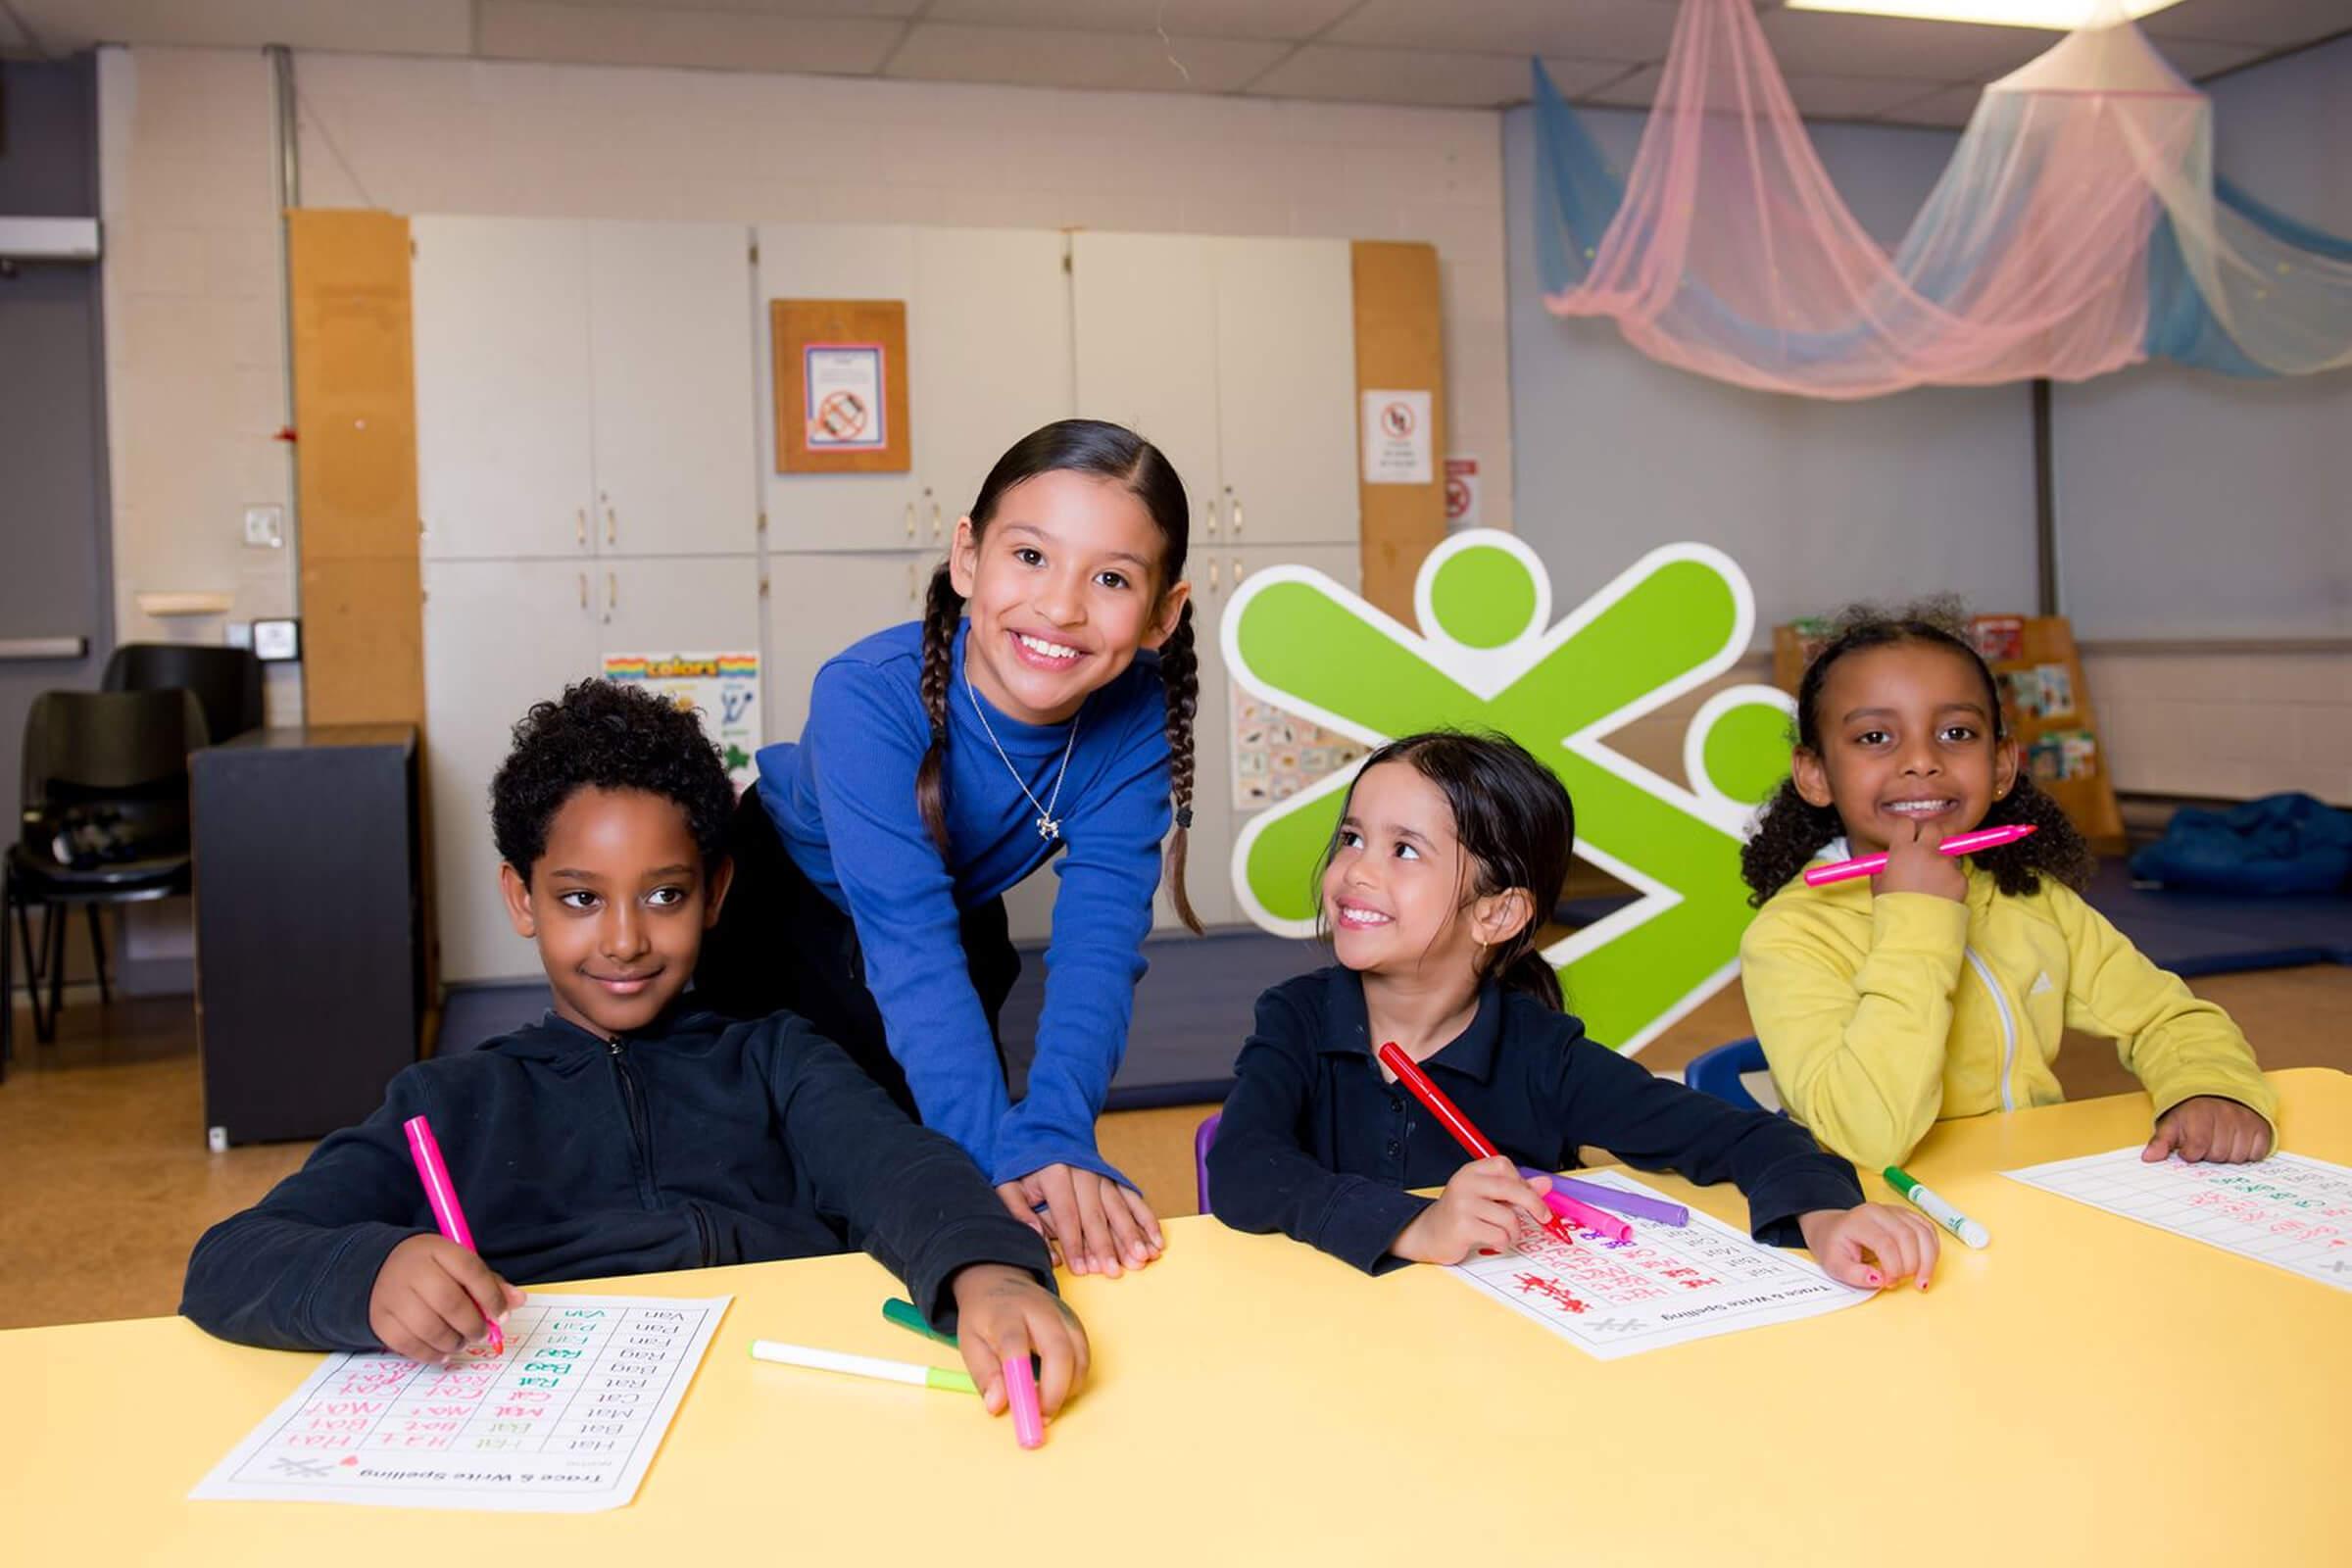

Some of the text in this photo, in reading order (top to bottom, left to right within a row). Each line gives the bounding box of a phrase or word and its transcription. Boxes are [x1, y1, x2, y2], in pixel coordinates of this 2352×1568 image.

[644, 654, 718, 679] colors
[1786, 1286, 1831, 1298] Trace
[1727, 1297, 1769, 1308] Write
[644, 1311, 684, 1321] Van
[1660, 1305, 1727, 1322] Spelling
[635, 1324, 679, 1334] Pan
[546, 1336, 588, 1345] Fan
[629, 1337, 671, 1347] Fan
[535, 1349, 583, 1358] Rag
[619, 1349, 666, 1360] Rag
[523, 1363, 571, 1375] Bag
[611, 1363, 658, 1374] Bag
[517, 1377, 560, 1389] Rat
[605, 1379, 647, 1389] Rat
[507, 1392, 552, 1401] Cat
[598, 1393, 640, 1403] Cat
[494, 1406, 545, 1418] Mat
[587, 1408, 634, 1418] Mat
[580, 1424, 623, 1434] Bat
[475, 1439, 521, 1449] Hat
[568, 1440, 614, 1451] Hat
[359, 1470, 447, 1481] Spelling
[454, 1473, 513, 1482] Write
[520, 1474, 533, 1483] &
